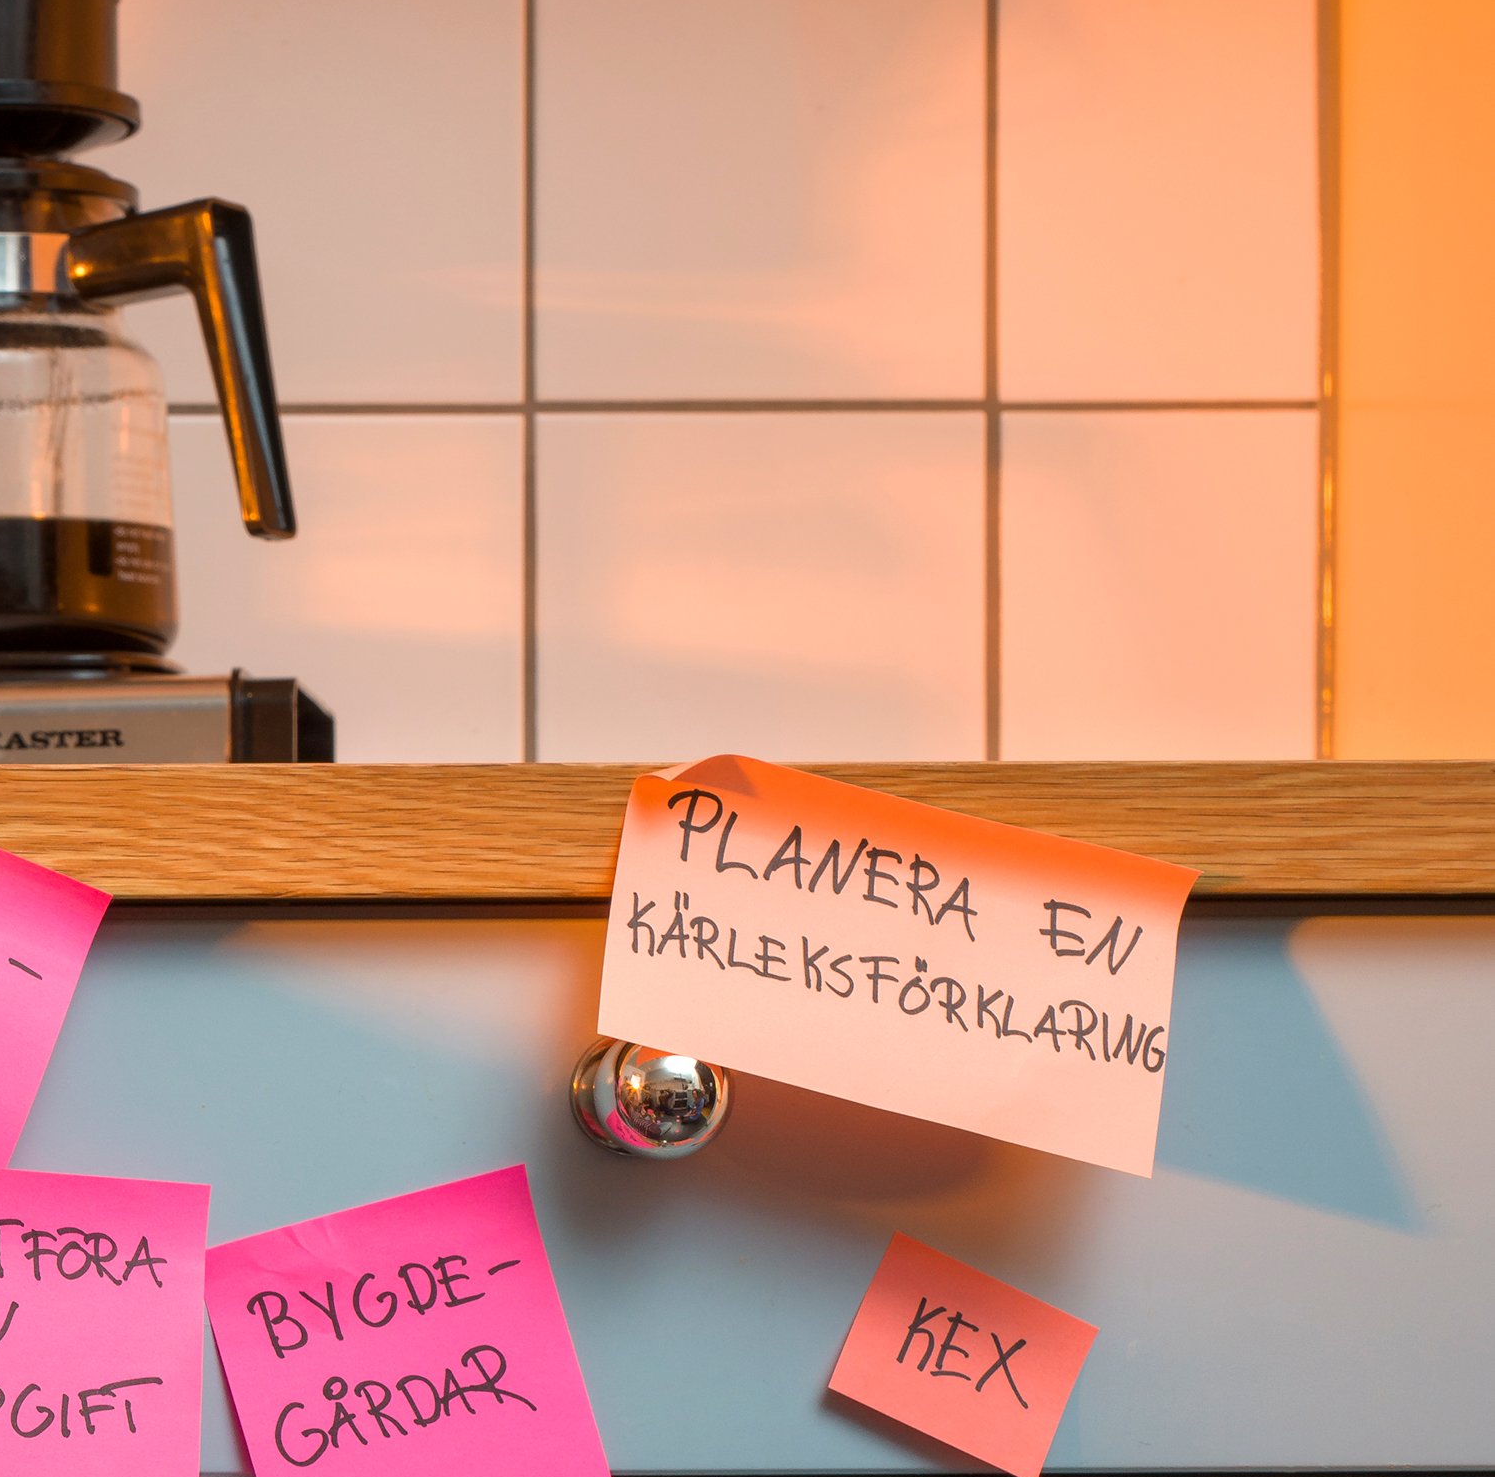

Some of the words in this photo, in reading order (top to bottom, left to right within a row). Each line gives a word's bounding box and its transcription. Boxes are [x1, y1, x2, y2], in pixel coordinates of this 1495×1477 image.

[667, 788, 978, 942] PLANERA
[1039, 899, 1143, 976] EN
[627, 891, 1166, 1074] KÄRLEKSFÖRKLARING
[246, 1254, 522, 1359] BYGDE-
[896, 1297, 1029, 1409] KEX
[274, 1343, 537, 1468] GÅRDAR
